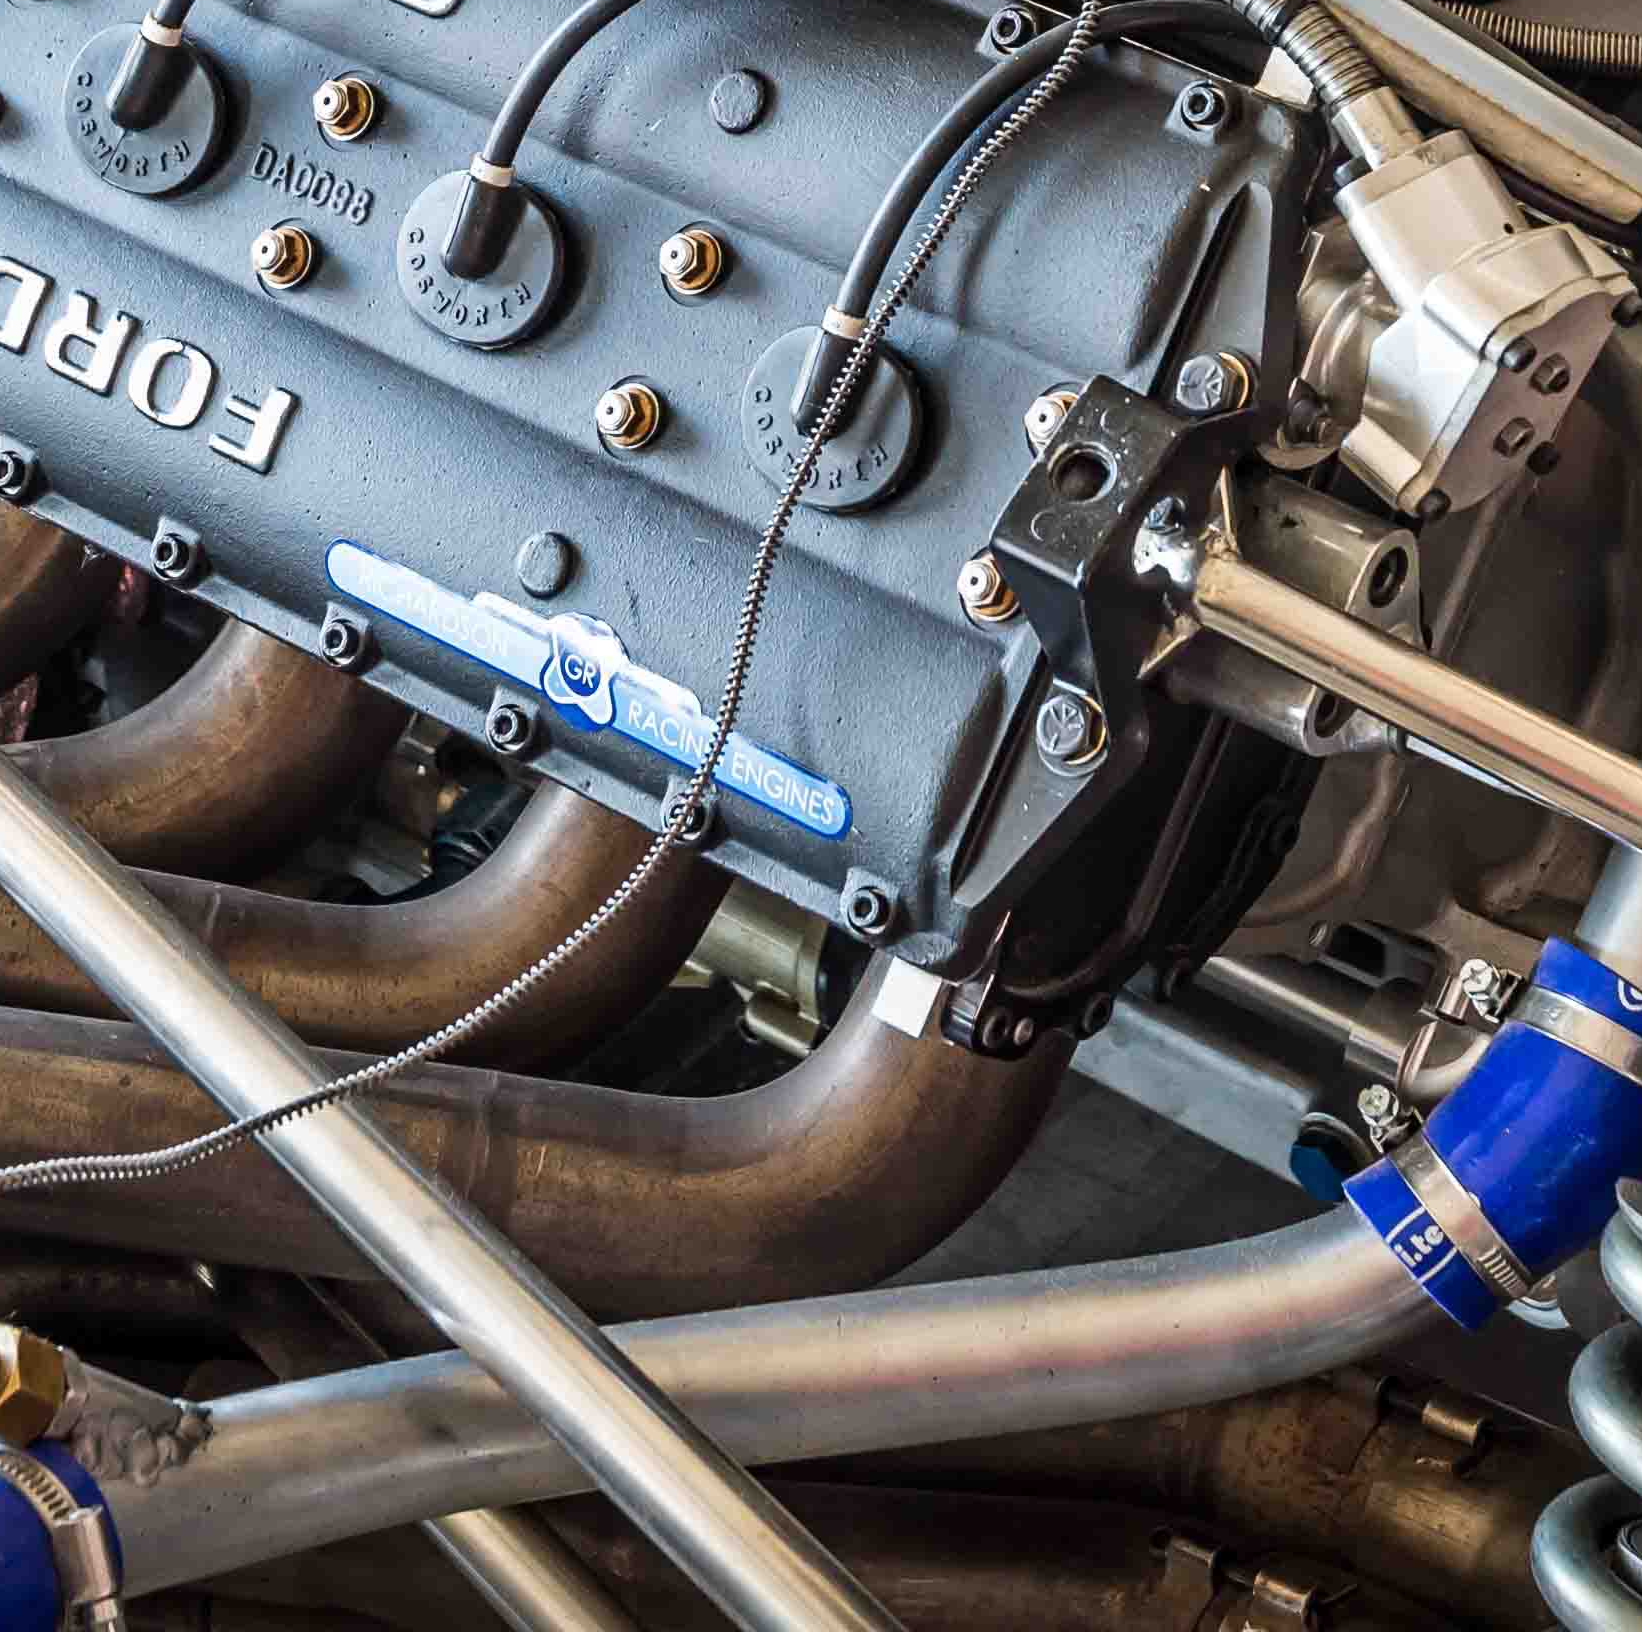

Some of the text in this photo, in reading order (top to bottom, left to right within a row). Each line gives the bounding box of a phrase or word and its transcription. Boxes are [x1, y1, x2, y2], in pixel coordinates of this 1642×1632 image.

[77, 72, 190, 176] COSWORTH
[410, 228, 531, 326] COSWORTH
[565, 654, 595, 688] GR
[628, 701, 723, 766] RACIN
[731, 752, 835, 824] ENGINES
